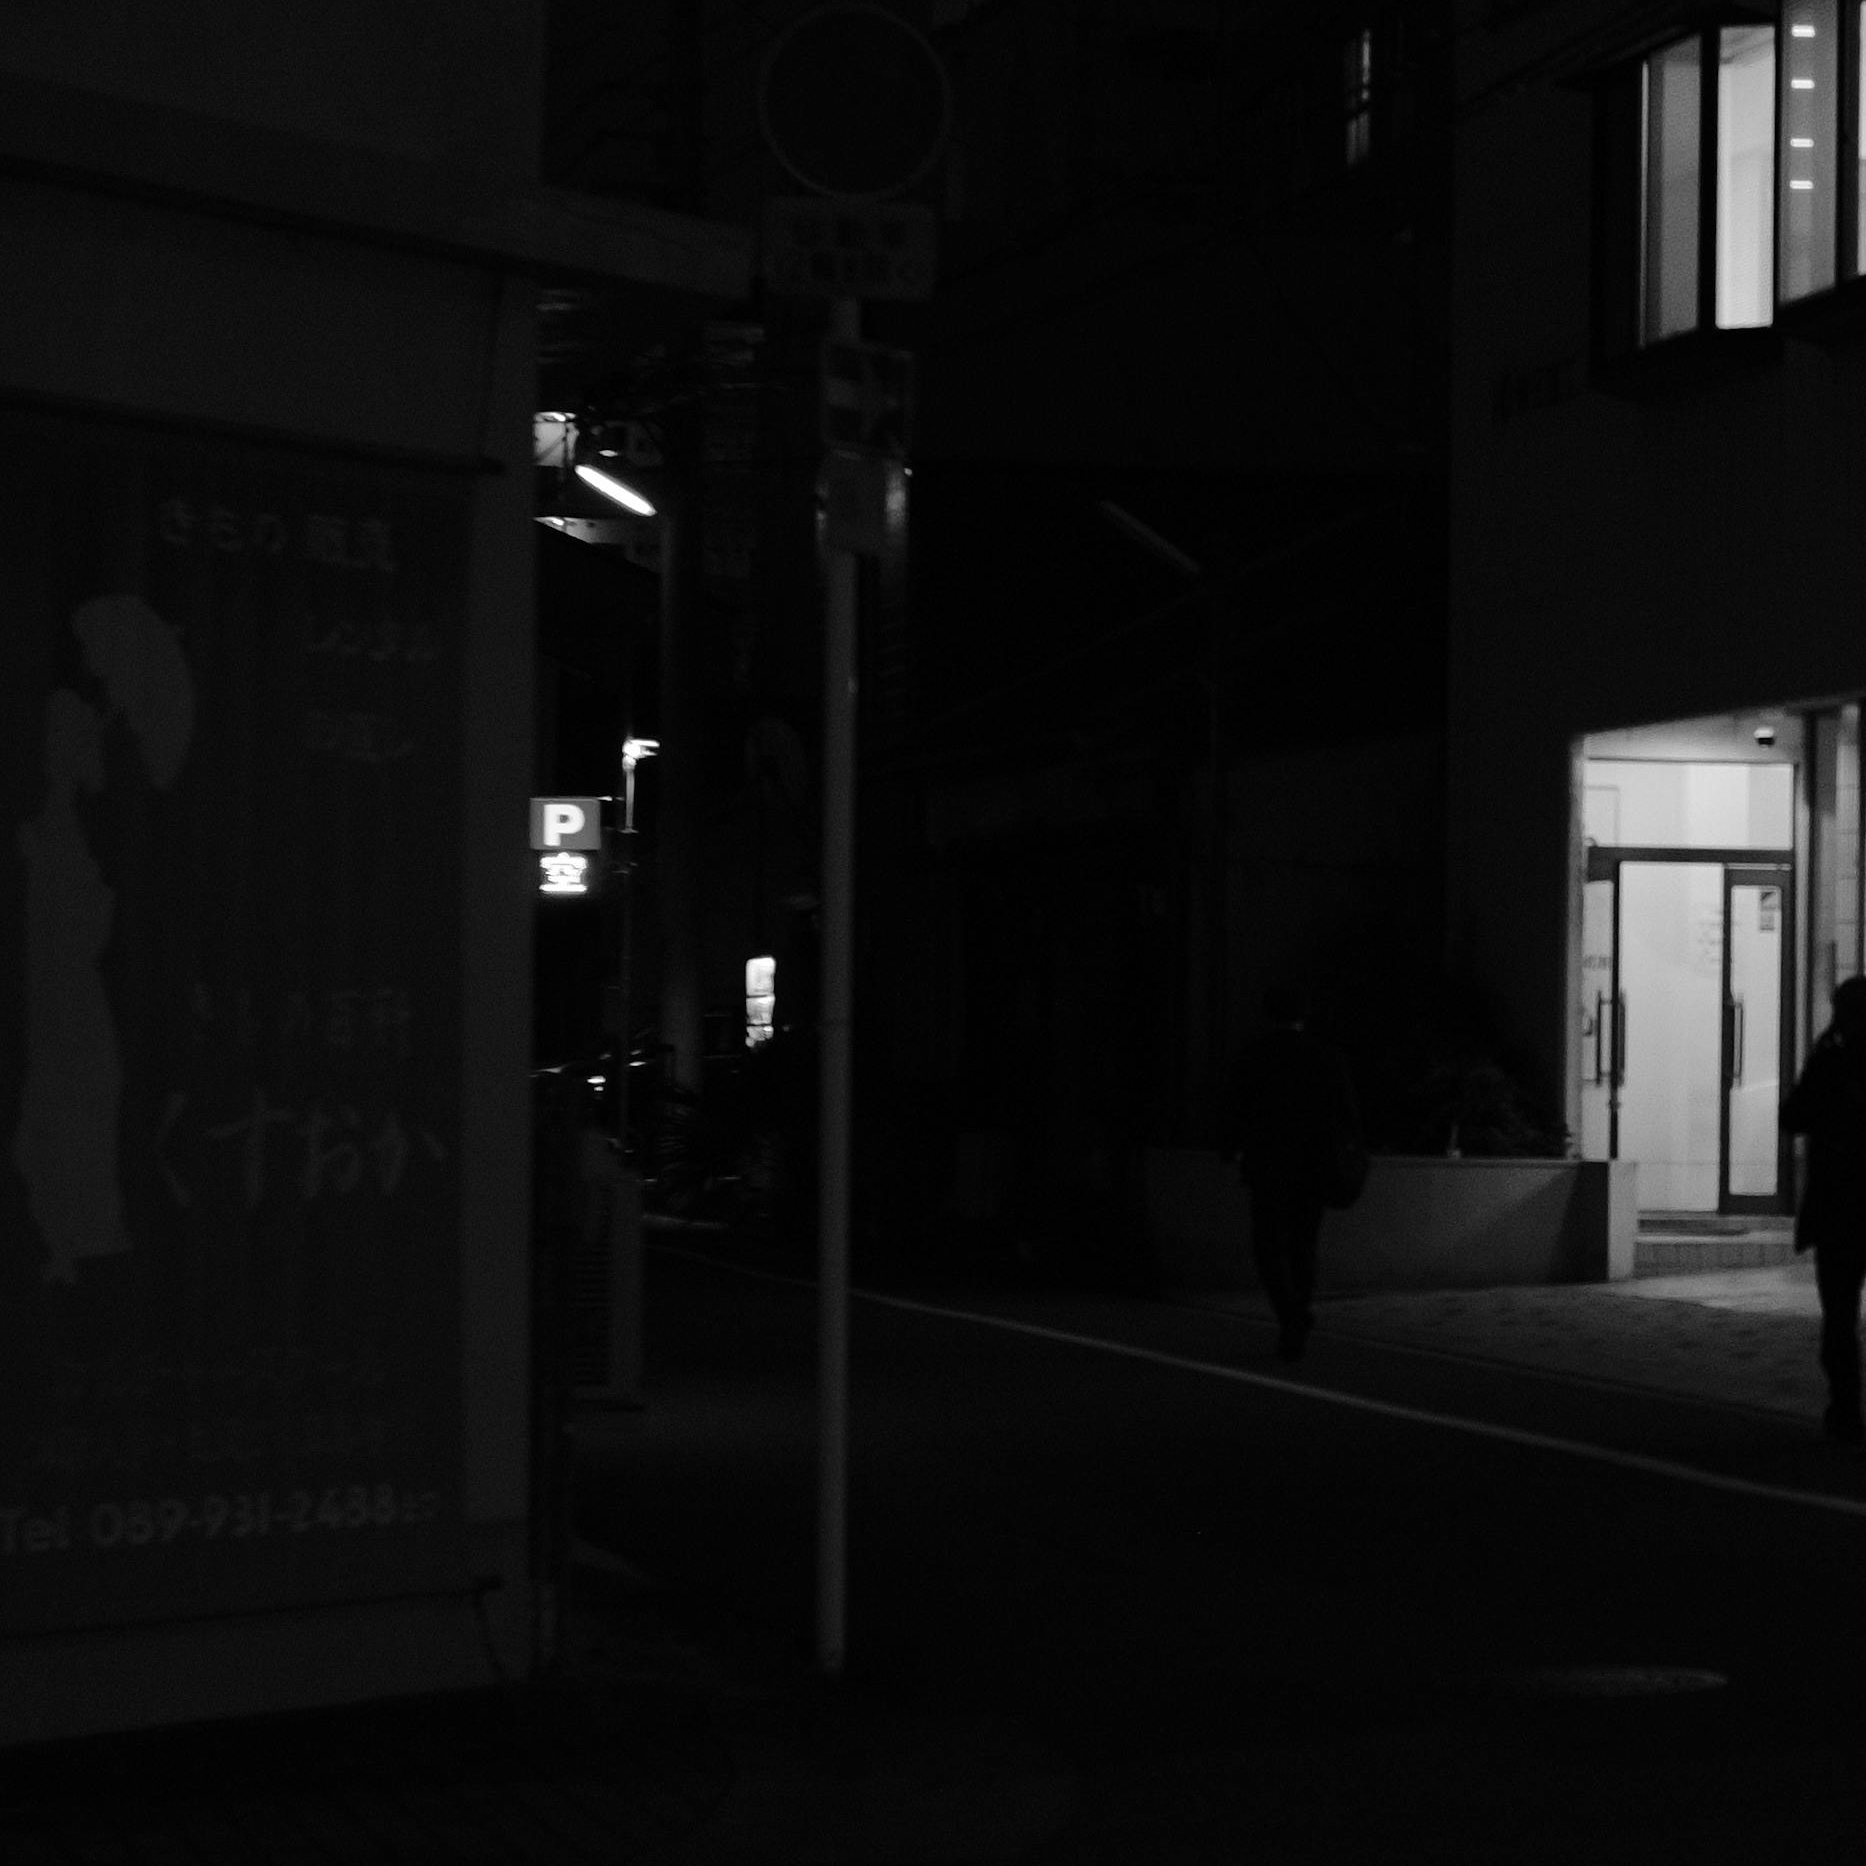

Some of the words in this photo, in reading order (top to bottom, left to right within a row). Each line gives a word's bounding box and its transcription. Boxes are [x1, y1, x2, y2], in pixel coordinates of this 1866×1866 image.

[543, 803, 585, 847] P
[155, 1087, 446, 1211] くすおか
